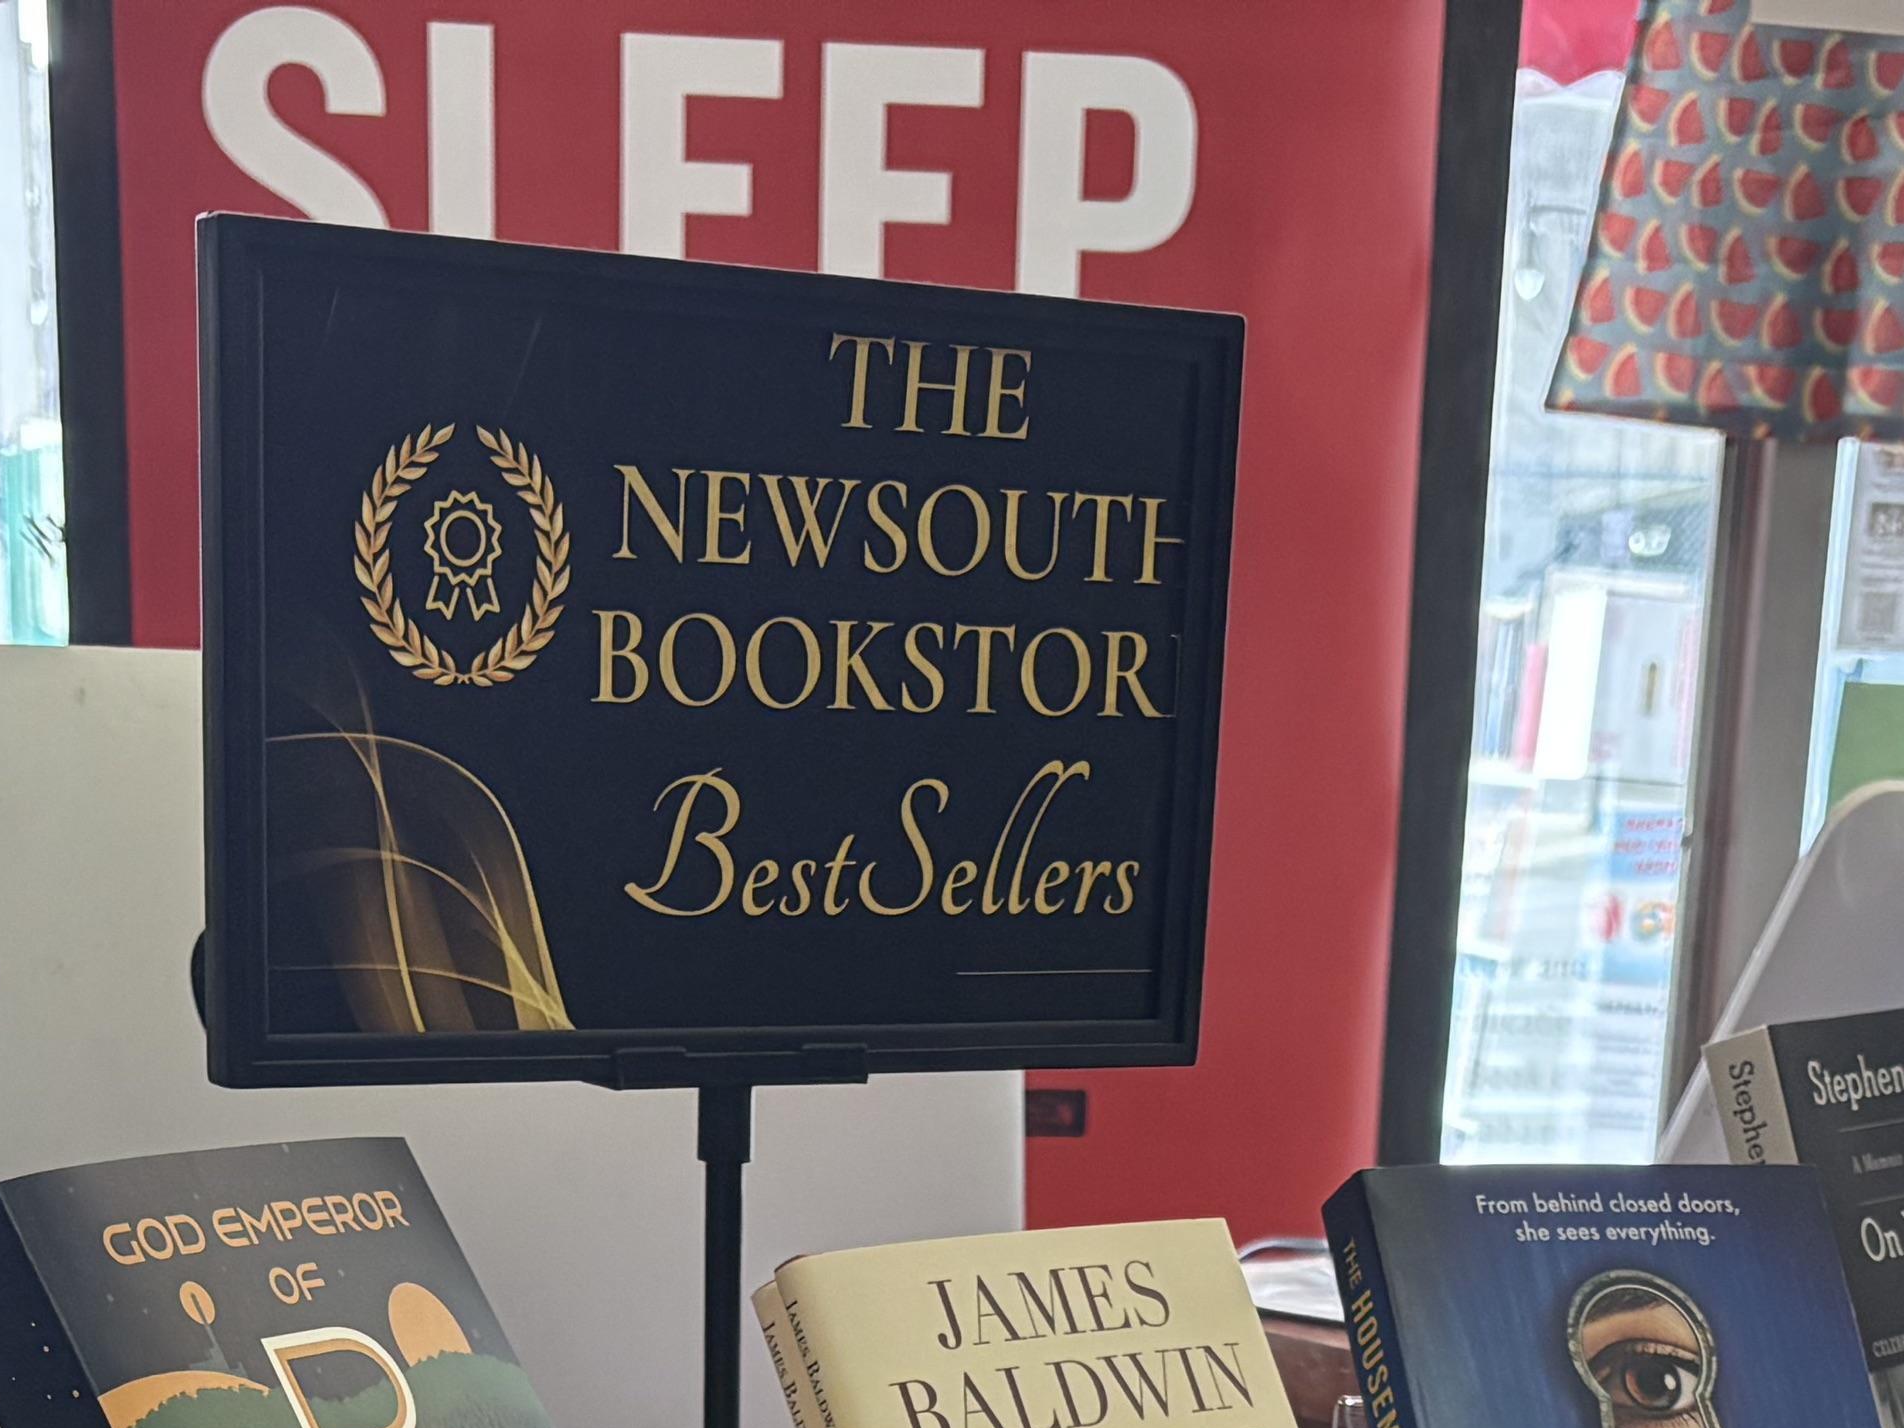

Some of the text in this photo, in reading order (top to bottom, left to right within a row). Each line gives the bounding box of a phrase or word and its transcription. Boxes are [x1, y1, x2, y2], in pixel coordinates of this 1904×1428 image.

[830, 332, 1033, 441] THE
[614, 464, 1184, 586] NEWSOUTH
[591, 611, 1178, 720] BOOKSTOR
[101, 1188, 412, 1268] GOD EMPEROR
[1474, 1191, 1742, 1217] From behind closed doors,
[1514, 1219, 1718, 1246] she sees everything.
[1860, 1216, 1904, 1262] On
[267, 1261, 328, 1306] OF
[927, 1259, 1172, 1351] JAMES
